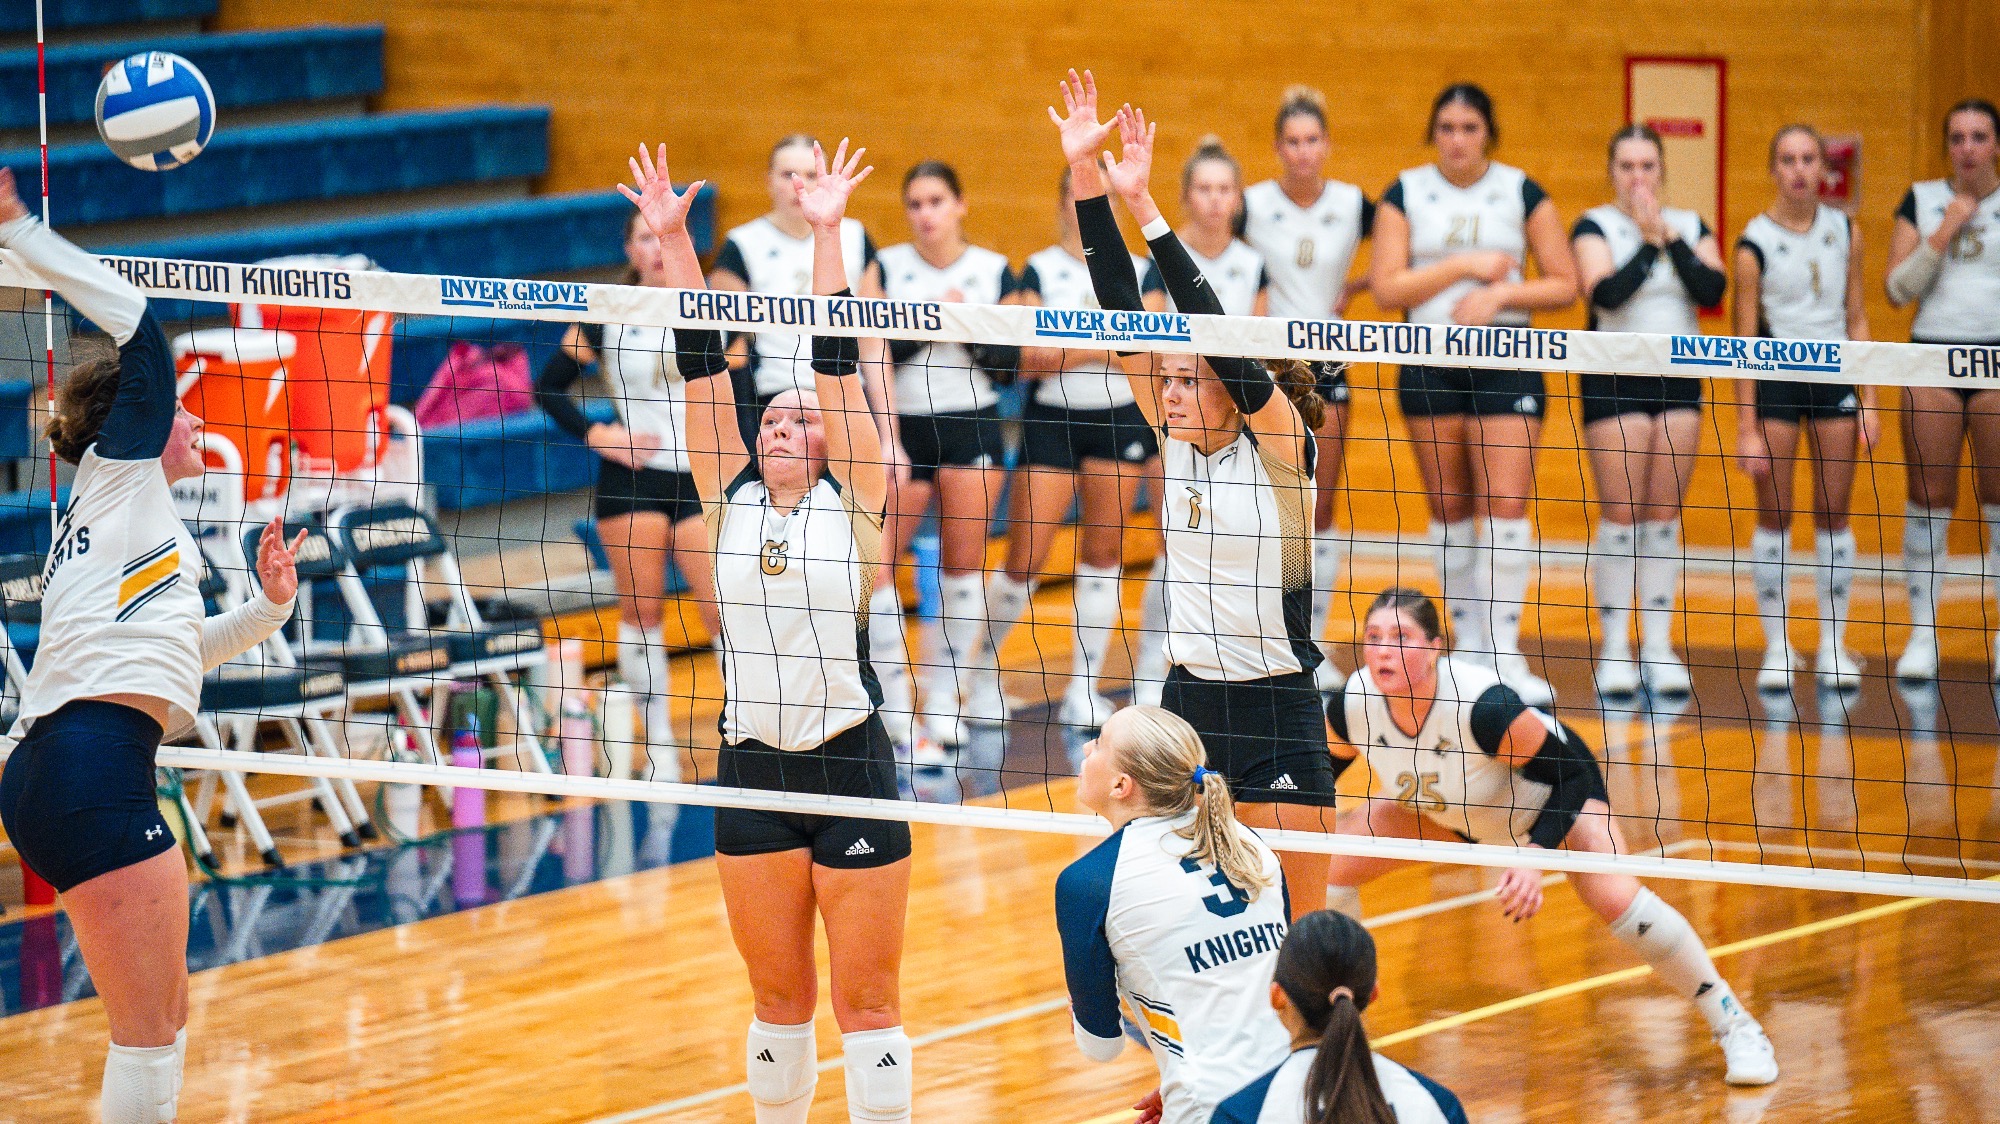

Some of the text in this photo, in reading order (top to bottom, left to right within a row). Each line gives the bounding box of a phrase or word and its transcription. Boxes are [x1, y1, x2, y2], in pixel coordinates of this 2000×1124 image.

[1446, 213, 1480, 247] 21
[241, 267, 352, 299] KNIGHTS
[441, 278, 588, 304] INVER GROVE
[498, 300, 533, 311] Honda
[679, 291, 942, 330] CARLETON KNIGHTS
[1036, 310, 1190, 334] INVER GROVE
[1095, 331, 1131, 341] Honda
[1287, 320, 1568, 360] CARLETON KNIGHTS
[1671, 336, 1841, 364] INVER GROVE
[1736, 359, 1776, 372] Honda
[760, 539, 789, 575] 6
[1396, 771, 1446, 812] 25
[845, 847, 875, 856] adidas
[1179, 850, 1251, 919] 3
[1184, 922, 1286, 974] KNIGHTS
